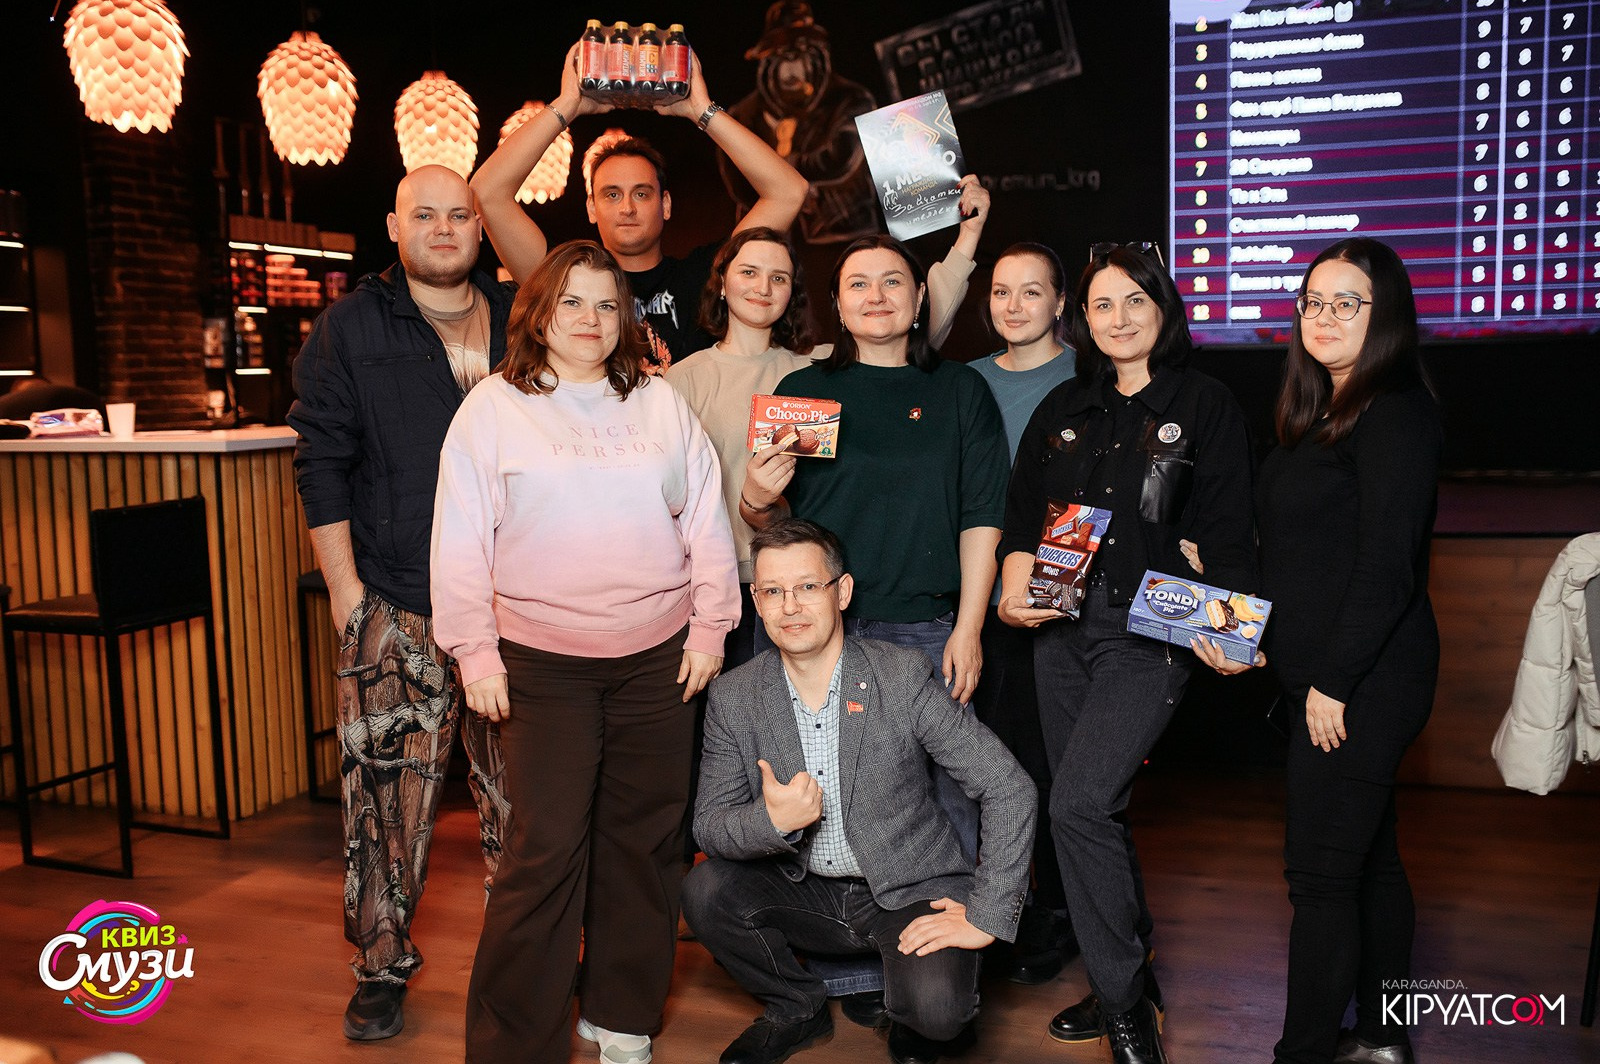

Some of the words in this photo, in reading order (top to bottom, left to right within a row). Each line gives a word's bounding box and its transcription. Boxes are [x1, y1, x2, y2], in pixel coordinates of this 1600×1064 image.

[1520, 16, 1532, 34] 7
[1562, 13, 1575, 30] 7
[1561, 44, 1574, 62] 7
[1560, 76, 1573, 94] 6
[1195, 131, 1208, 149] 6
[1476, 113, 1489, 131] 7
[1516, 110, 1530, 128] 6
[1559, 107, 1572, 125] 6
[1195, 160, 1208, 177] 7
[1475, 143, 1489, 161] 7
[1515, 141, 1529, 159] 6
[1558, 138, 1571, 156] 6
[882, 180, 895, 196] 1
[895, 150, 958, 191] МЕО
[1473, 205, 1487, 223] 7
[1555, 201, 1569, 218] 4
[1554, 232, 1568, 249] 4
[1511, 294, 1525, 312] 4
[788, 402, 812, 410] ORION
[569, 423, 640, 439] NICE
[551, 442, 666, 458] PERSON
[1036, 545, 1083, 568] SNICKERS
[1144, 589, 1199, 610] TONDI
